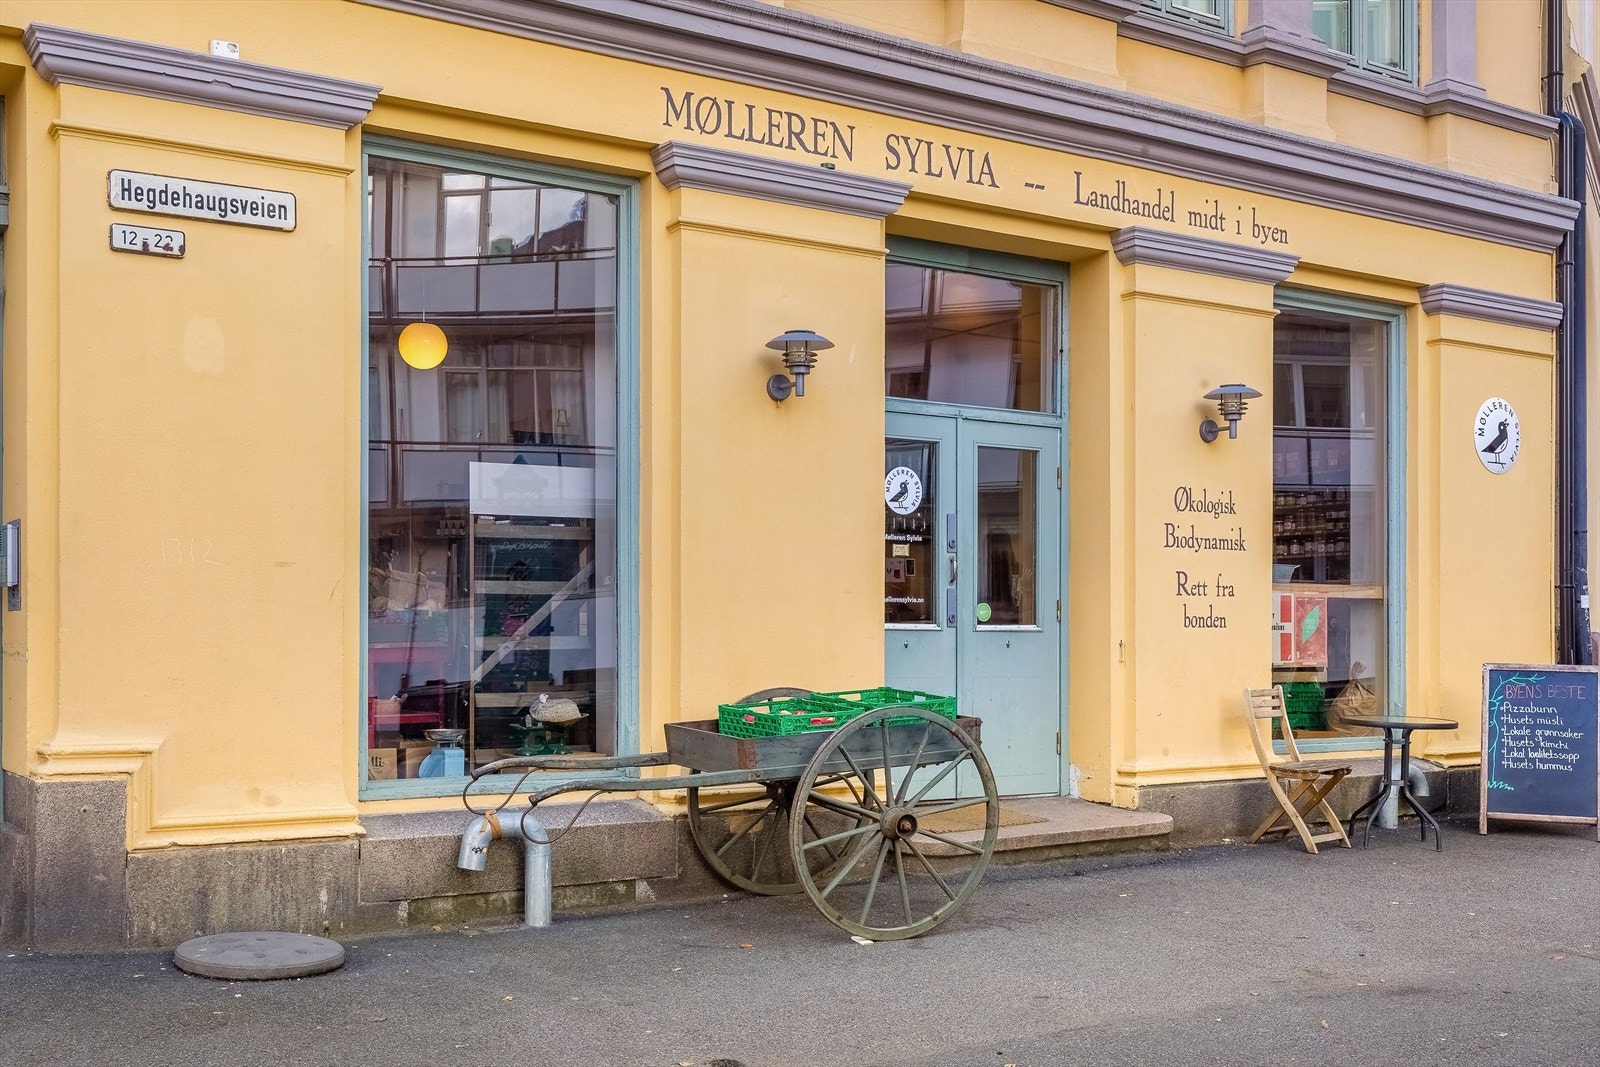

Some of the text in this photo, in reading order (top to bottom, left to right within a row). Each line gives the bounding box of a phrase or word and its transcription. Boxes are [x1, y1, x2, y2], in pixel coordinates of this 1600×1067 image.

[660, 86, 856, 162] MØLLEREN
[885, 133, 1001, 189] SYLVIA
[1073, 171, 1176, 223] Landhandel
[1187, 199, 1226, 232] midt
[1235, 206, 1242, 235] i
[1251, 207, 1289, 245] byen
[120, 177, 288, 221] Hegdehaugsveien
[121, 229, 138, 246] 12
[1478, 401, 1521, 462] MØLLEREN SYLVIA
[886, 469, 921, 507] MØLLEREN SYLVIA
[1174, 486, 1237, 519] Økologisk
[906, 534, 923, 543] Sylvia
[1163, 522, 1247, 553] Biodynamisk
[1175, 570, 1235, 598] Rett fra
[1182, 603, 1227, 629] bonden
[1505, 684, 1586, 700] BYENS BESTE
[1503, 701, 1558, 713] Pizzabunn
[1503, 713, 1534, 724] Husets
[1503, 725, 1584, 741] Lokale grønnsaker
[1504, 735, 1570, 750] Husets kimchi
[1504, 747, 1580, 763] Lokal kvalitetssopp
[1504, 758, 1573, 772] Husets hummus
